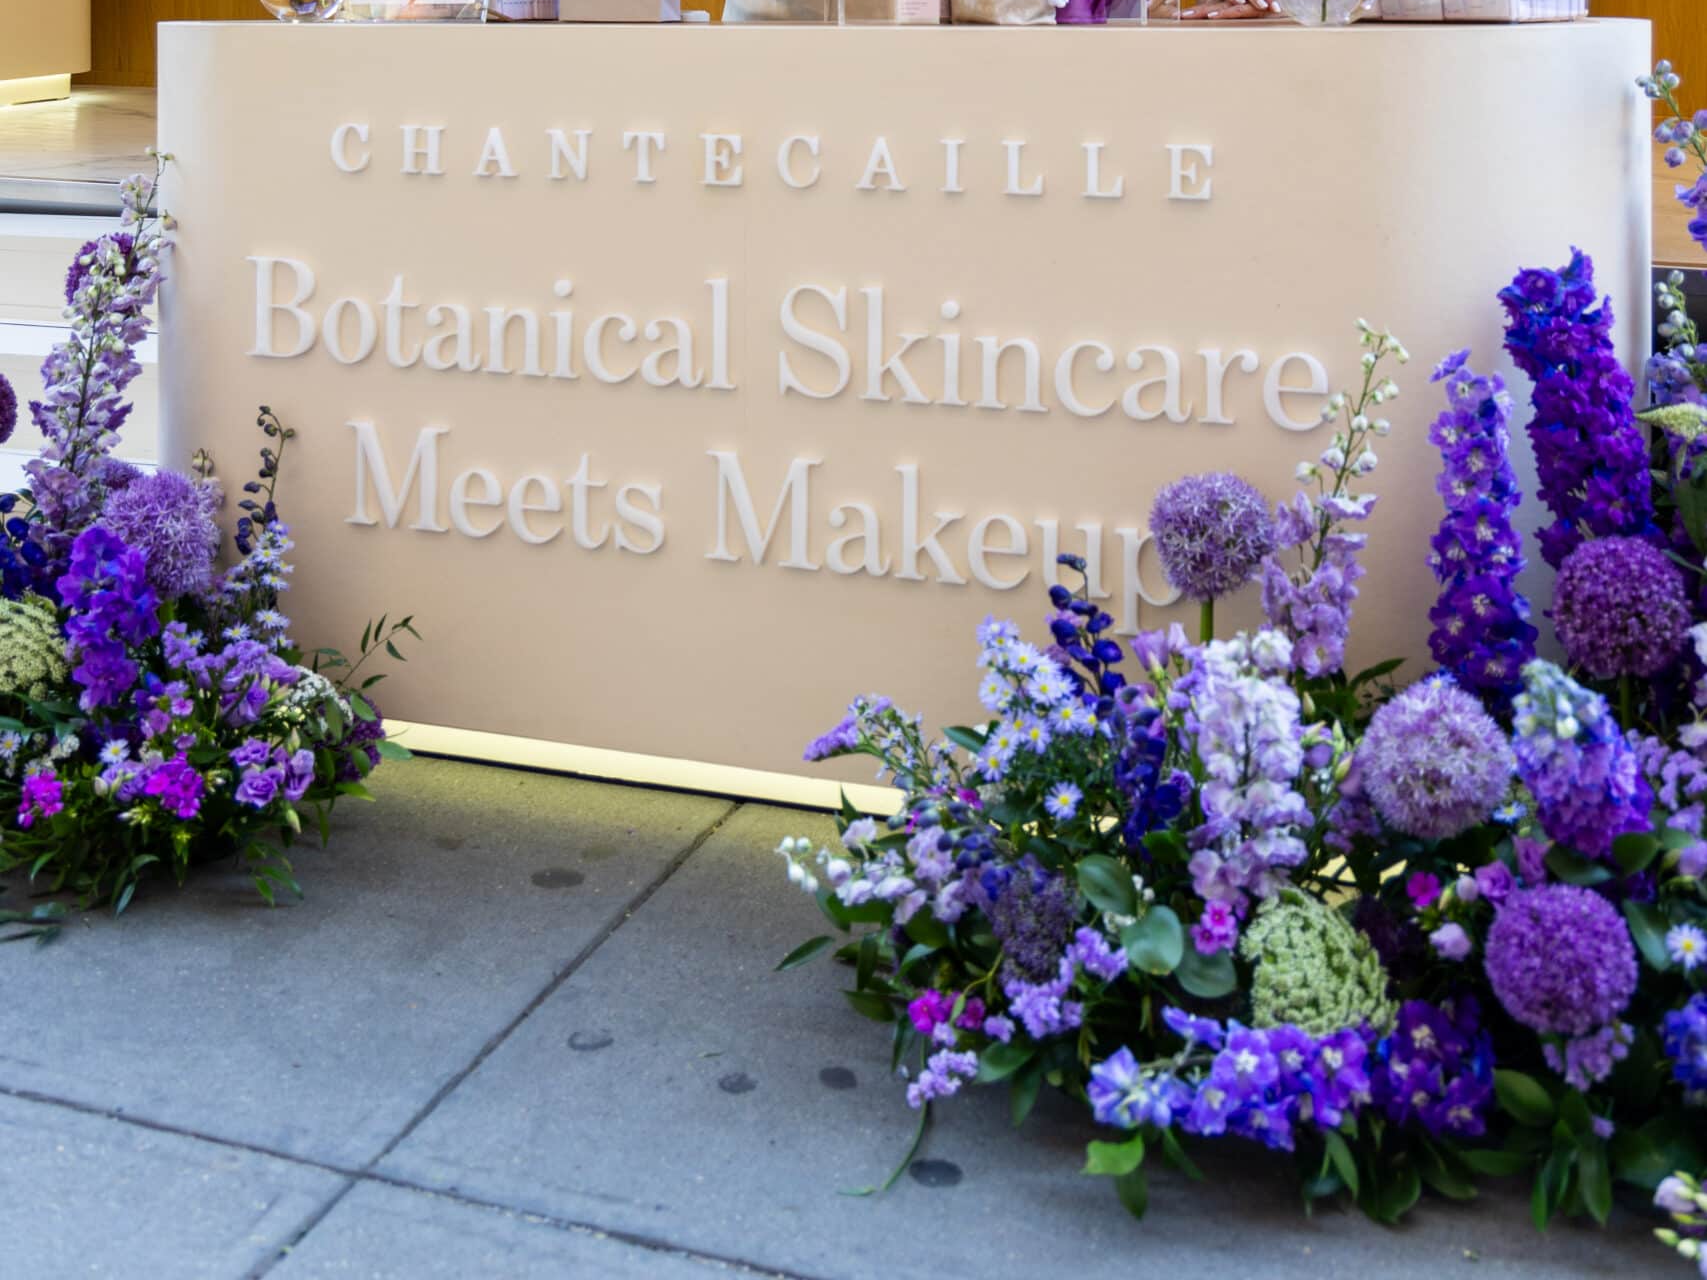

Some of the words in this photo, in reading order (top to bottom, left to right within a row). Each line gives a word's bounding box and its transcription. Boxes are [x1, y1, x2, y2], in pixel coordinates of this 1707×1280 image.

[329, 122, 1214, 200] CHANTECAILLE
[245, 255, 738, 390] Botanical
[777, 283, 1330, 432] Skincare
[344, 421, 666, 555] Meets
[704, 450, 1184, 636] Makeup
